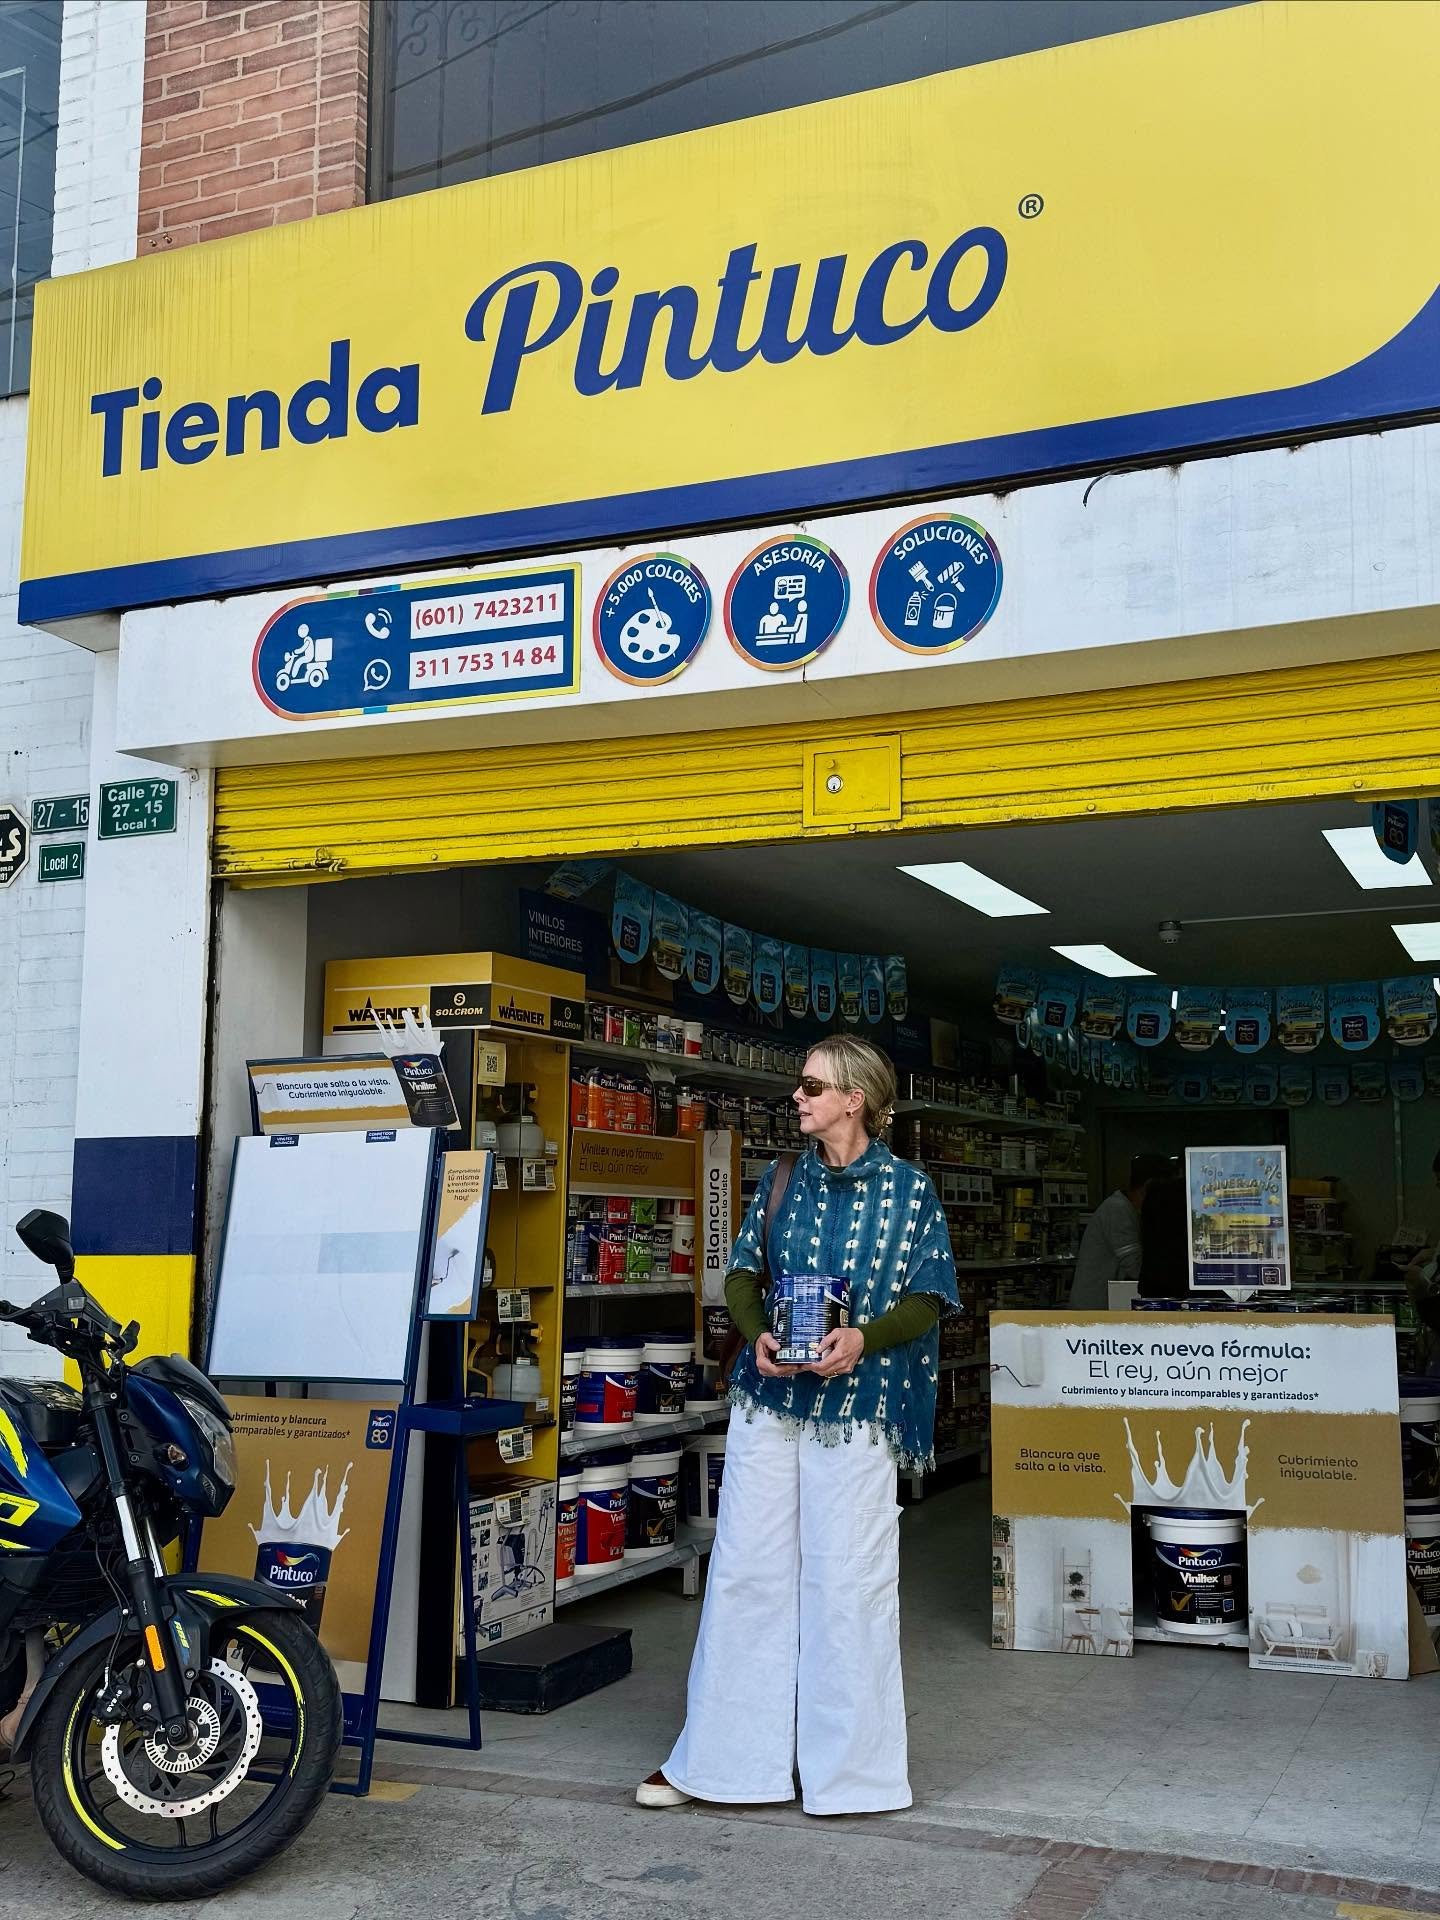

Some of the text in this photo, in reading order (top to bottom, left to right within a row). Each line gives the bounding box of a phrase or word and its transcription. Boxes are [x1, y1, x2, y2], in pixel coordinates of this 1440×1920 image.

[90, 339, 420, 478] Tienda
[464, 226, 1008, 415] Pintuco
[893, 525, 989, 566] SOLUCIONES
[753, 547, 827, 577] ASESORÍA
[608, 569, 643, 606] 5.000
[645, 564, 702, 603] COLORES
[415, 592, 557, 631] (601) 7423211
[415, 645, 557, 679] 311 753 14 84
[108, 782, 169, 802] Calle 79
[37, 802, 55, 829] 27
[72, 799, 89, 825] 15
[112, 804, 130, 818] 27
[145, 800, 163, 815] 15
[115, 818, 157, 832] Local 1
[44, 853, 79, 872] Local 2
[528, 908, 566, 931] VINILOS
[528, 927, 584, 953] INTERIORES
[434, 1007, 484, 1017] SOLCROM
[498, 1005, 545, 1026] WAGNER
[403, 1067, 433, 1076] Pintuco
[276, 1082, 312, 1090] Blancura
[313, 1080, 328, 1090] que
[330, 1079, 350, 1088] salta
[359, 1079, 367, 1087] la
[368, 1078, 391, 1086] vista.
[288, 1089, 337, 1099] Cubrimiento
[721, 1199, 728, 1209] la
[706, 1168, 720, 1269] Blancura
[1066, 1339, 1311, 1359] Viniltex nueva fórmula:
[1089, 1360, 1289, 1387] El rey, aún mejor
[1061, 1386, 1118, 1396] Cubrimiento
[1120, 1389, 1127, 1398] y
[1128, 1387, 1169, 1397] blancura
[1171, 1388, 1241, 1399] incomparables
[1243, 1391, 1249, 1400] y
[231, 1412, 327, 1426] ubrimiento y blancura
[287, 1428, 293, 1438] y
[371, 1428, 389, 1444] 80
[1020, 1448, 1101, 1462] Blancura que
[1278, 1454, 1359, 1468] Cubrimiento
[1015, 1461, 1106, 1473] salta a la vista.
[1280, 1467, 1357, 1481] inigualable.
[1178, 1556, 1218, 1567] Pintuco
[270, 1565, 313, 1582] Pintuco
[1180, 1571, 1220, 1585] Viniltex
